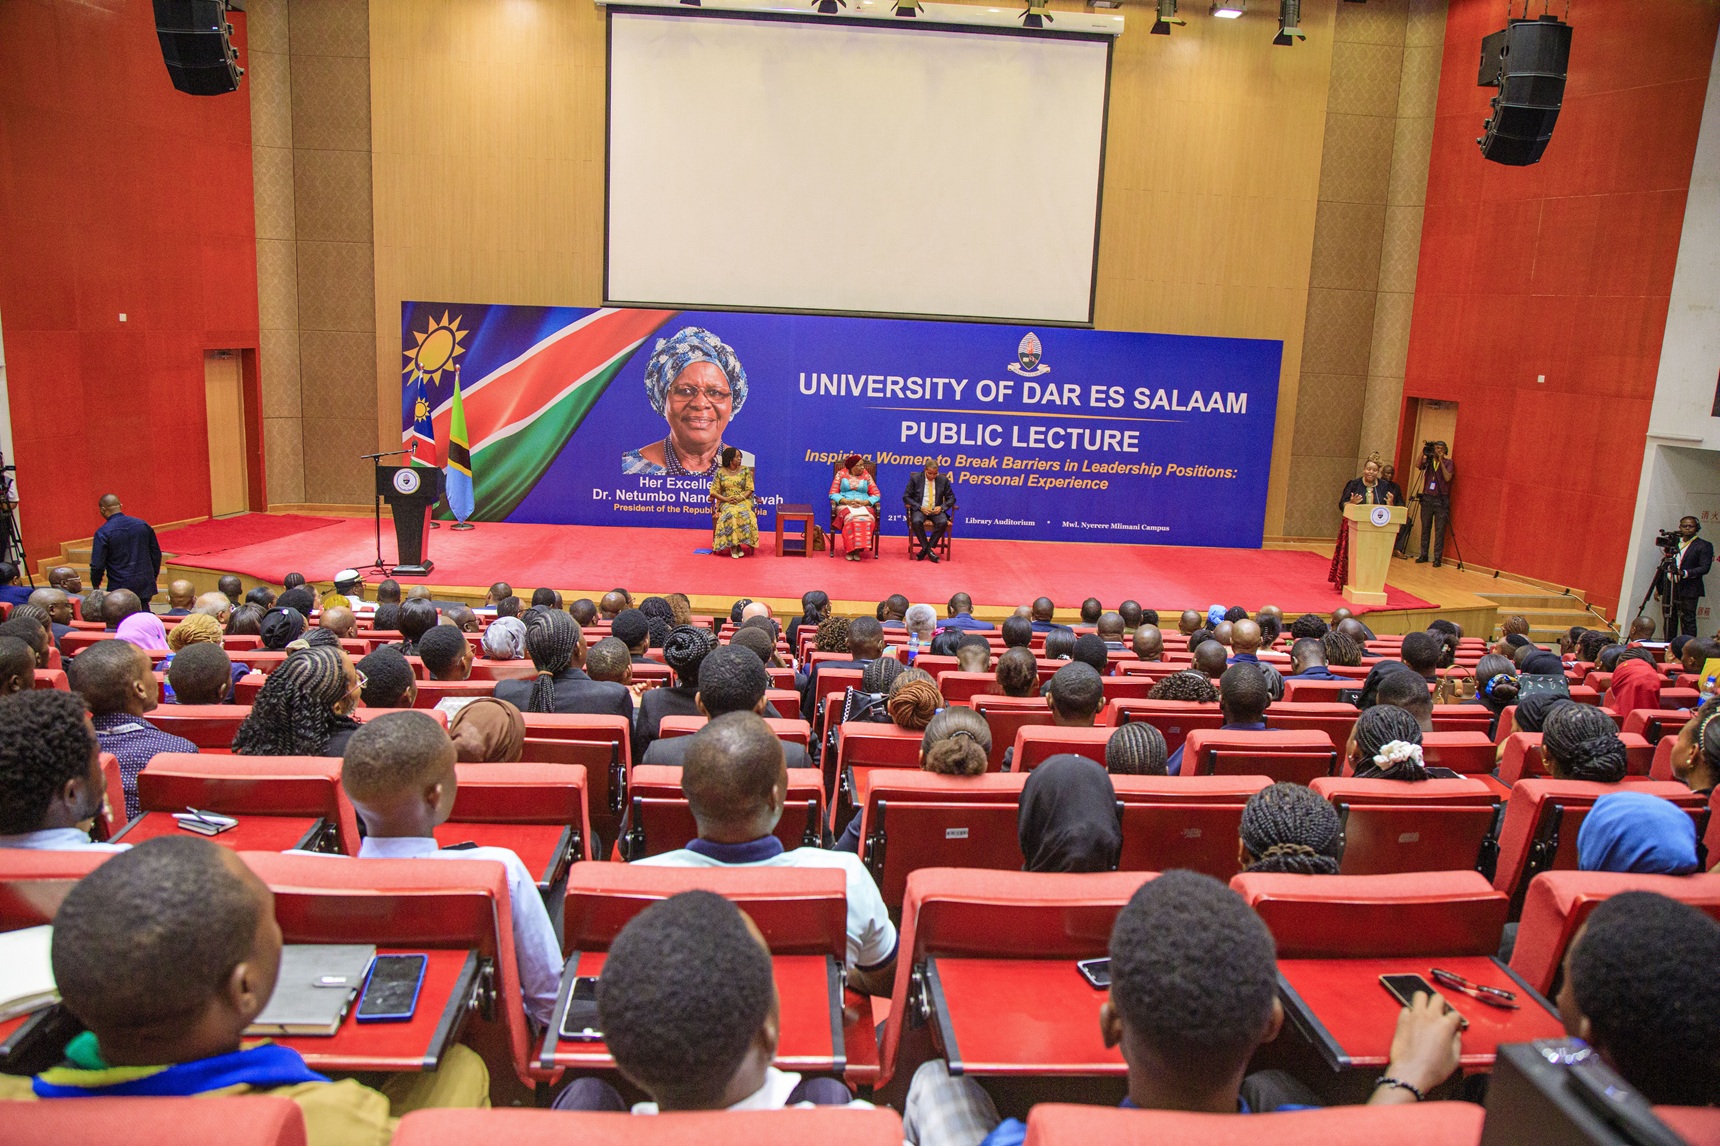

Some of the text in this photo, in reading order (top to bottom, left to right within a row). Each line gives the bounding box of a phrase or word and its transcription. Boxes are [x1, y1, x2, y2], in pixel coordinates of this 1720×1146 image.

[799, 372, 1248, 414] UNIVERSITY OF DAR ES SALAAM
[900, 421, 1140, 453] PUBLIC LECTURE
[937, 454, 951, 467] to
[955, 453, 998, 469] Break
[1002, 456, 1061, 472] Barriers
[1064, 459, 1078, 472] in
[1082, 460, 1162, 478] Leadership
[1166, 463, 1238, 479] Positions:
[639, 476, 712, 490] Her Excelle
[959, 471, 1025, 486] Personal
[1027, 474, 1109, 490] Experience
[592, 488, 612, 500] Dr.
[616, 489, 676, 502] Netumbo
[613, 503, 713, 515] President of the Republ
[965, 517, 1036, 527] Library Auditorium
[1081, 521, 1110, 530] Nyerere
[1110, 522, 1140, 530] Mlimani
[1141, 523, 1170, 532] Campus
